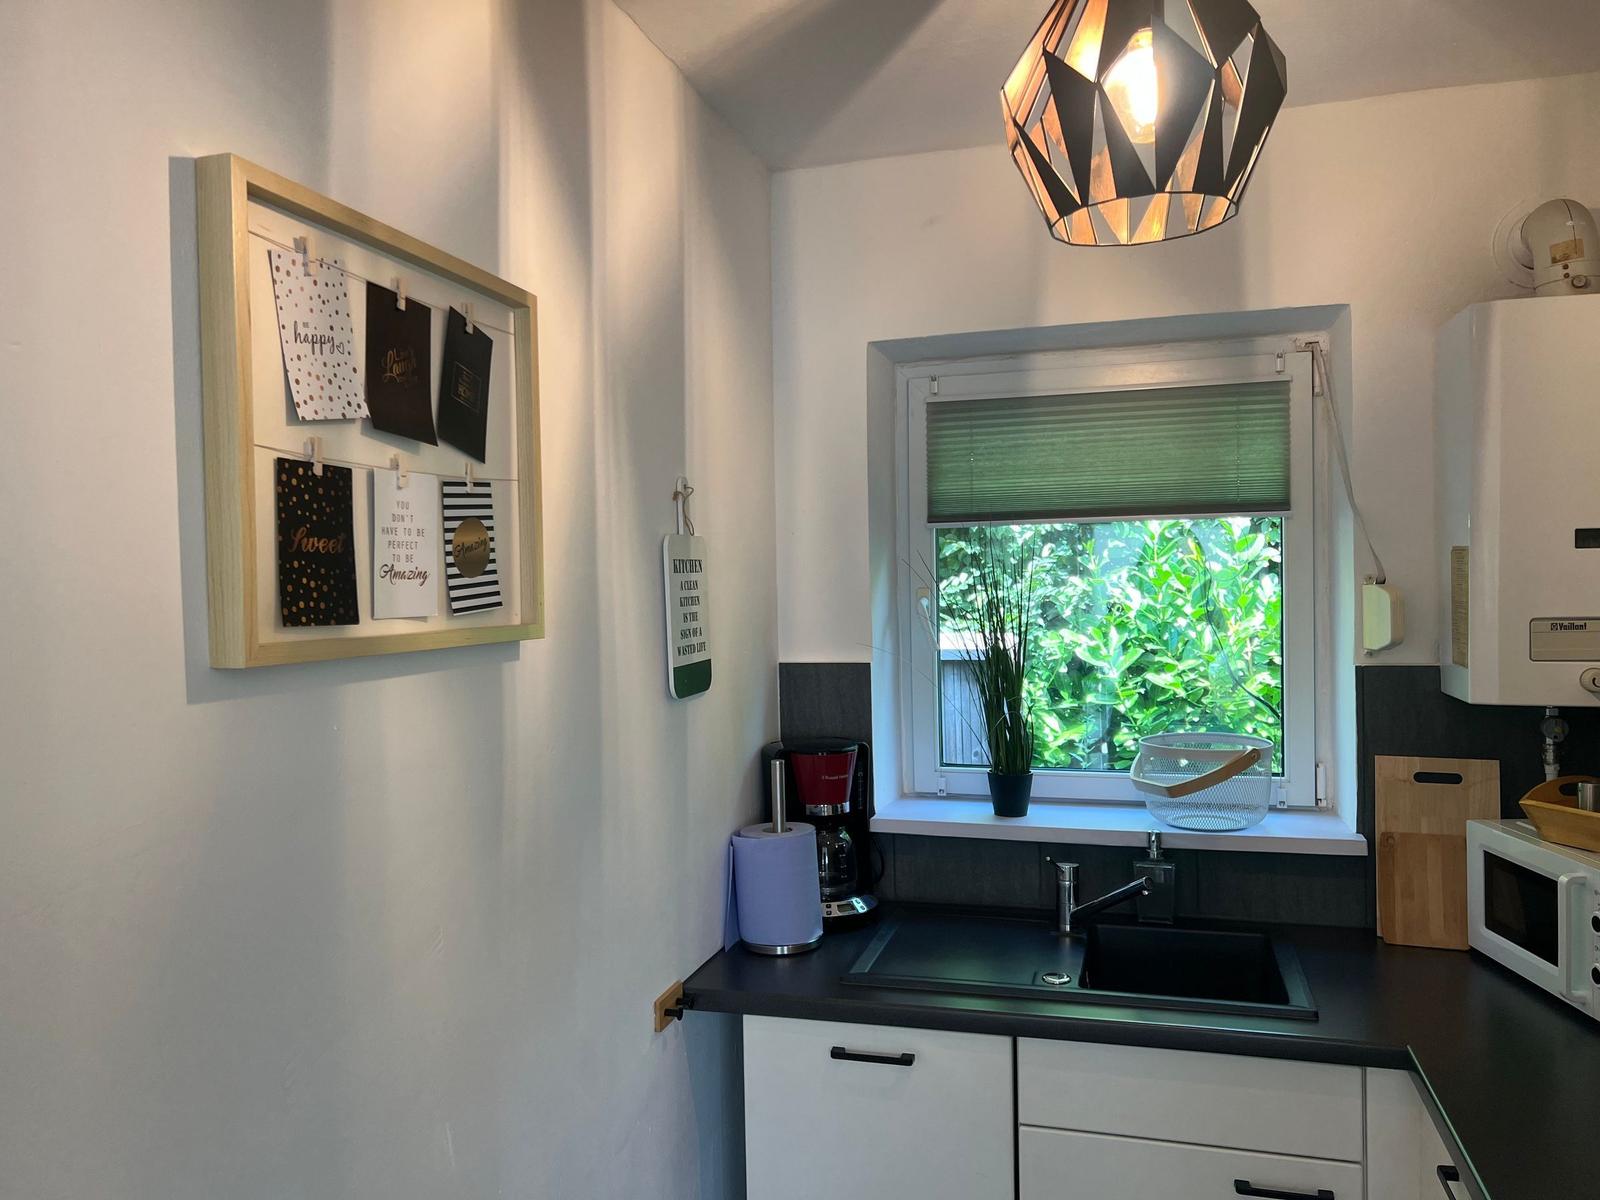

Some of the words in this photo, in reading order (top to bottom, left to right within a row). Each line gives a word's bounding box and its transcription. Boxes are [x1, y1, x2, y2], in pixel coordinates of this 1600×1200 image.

[293, 320, 335, 356] happy
[396, 501, 410, 510] YOU
[391, 513, 414, 523] DON'T
[381, 526, 399, 536] HAVE
[403, 527, 412, 537] TO
[416, 528, 425, 538] BE
[288, 527, 345, 553] Sweet
[387, 540, 419, 550] PERFECT
[392, 553, 401, 562] TO
[405, 554, 414, 563] BE
[673, 558, 703, 574] KITCHEN
[379, 564, 428, 587] Amazing
[680, 580, 684, 591] A
[684, 580, 699, 591] CLEAN
[680, 596, 700, 607] KITCHEN
[683, 612, 689, 623] IS
[689, 611, 698, 622] THE
[1559, 622, 1587, 631] Vaillant
[680, 629, 691, 640] SIGN
[692, 627, 698, 638] OF
[677, 644, 696, 656] WASTED
[696, 642, 706, 653] LIFE
